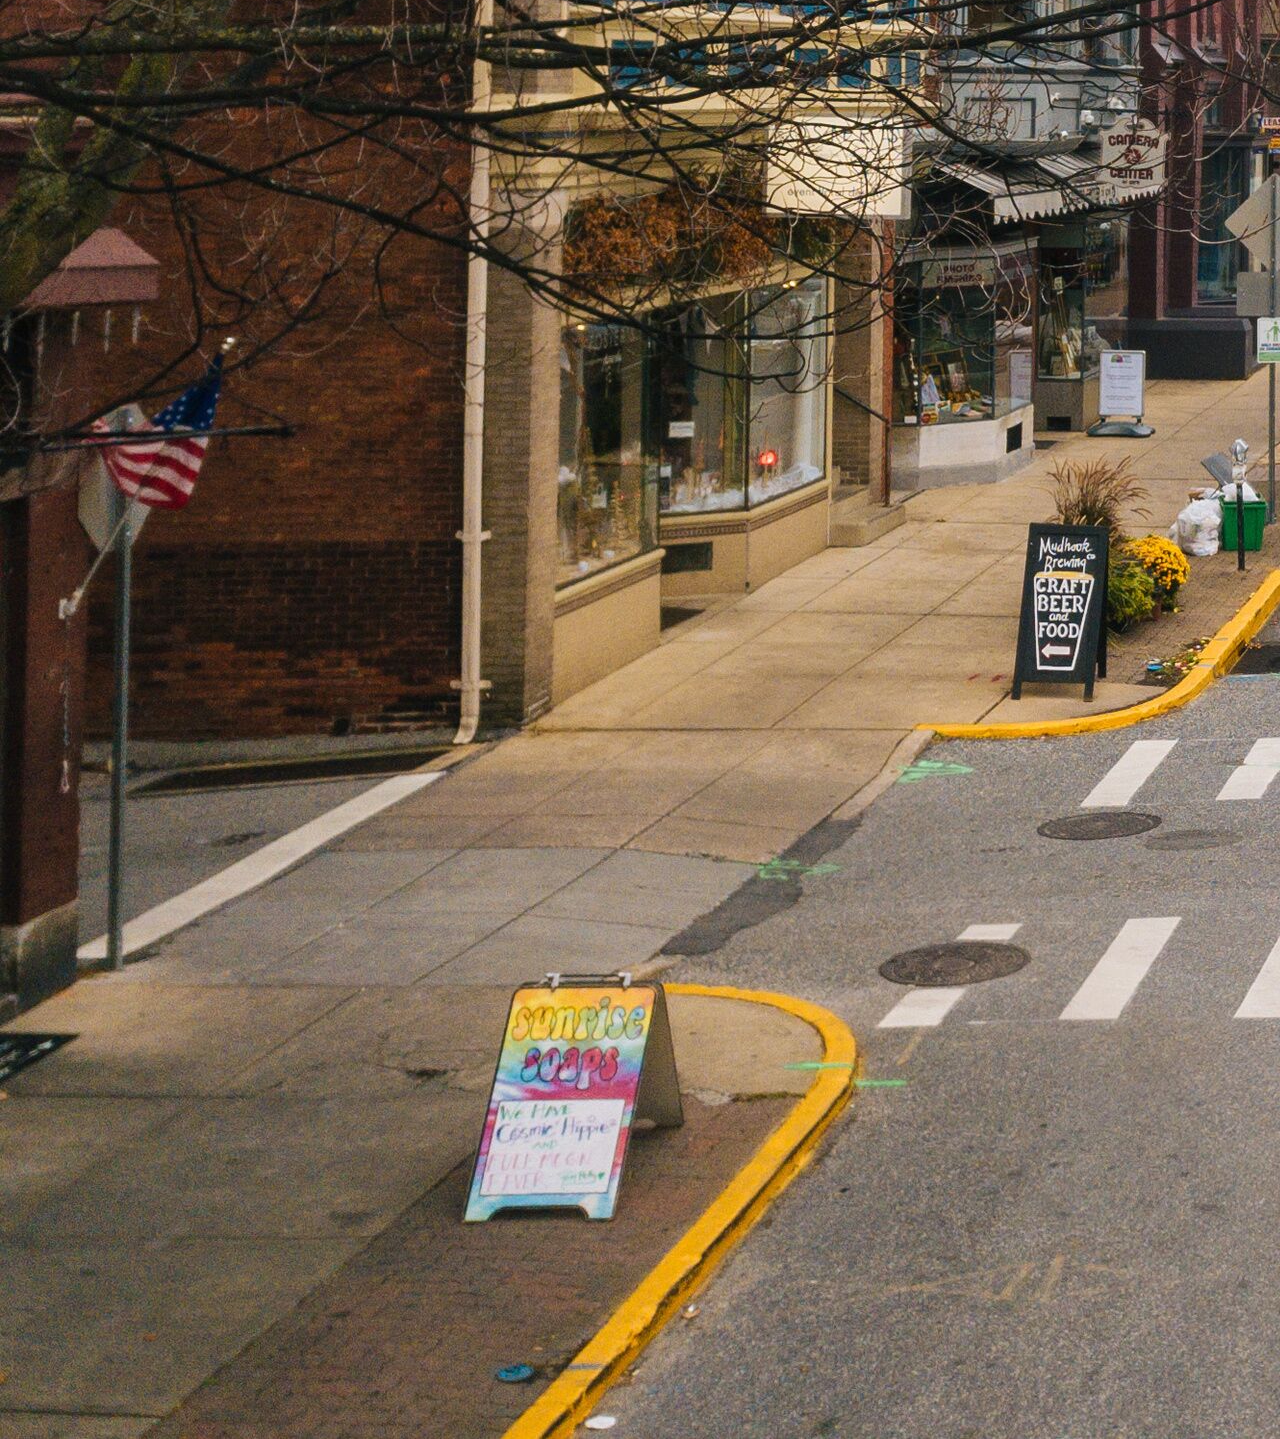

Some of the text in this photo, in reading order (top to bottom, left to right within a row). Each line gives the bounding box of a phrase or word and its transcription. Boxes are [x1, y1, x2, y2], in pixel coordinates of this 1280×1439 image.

[1107, 133, 1160, 150] CAMERA
[1109, 167, 1154, 181] CENTER
[943, 264, 975, 273] PHOTO
[1038, 535, 1094, 561] Mudhook
[1043, 554, 1088, 575] Brewing
[1035, 577, 1090, 595] CRAFT
[1037, 594, 1085, 613] BEER
[1048, 612, 1070, 622] and
[1037, 621, 1081, 639] FOOD
[510, 995, 647, 1042] sunrise
[519, 1046, 620, 1092] soaps
